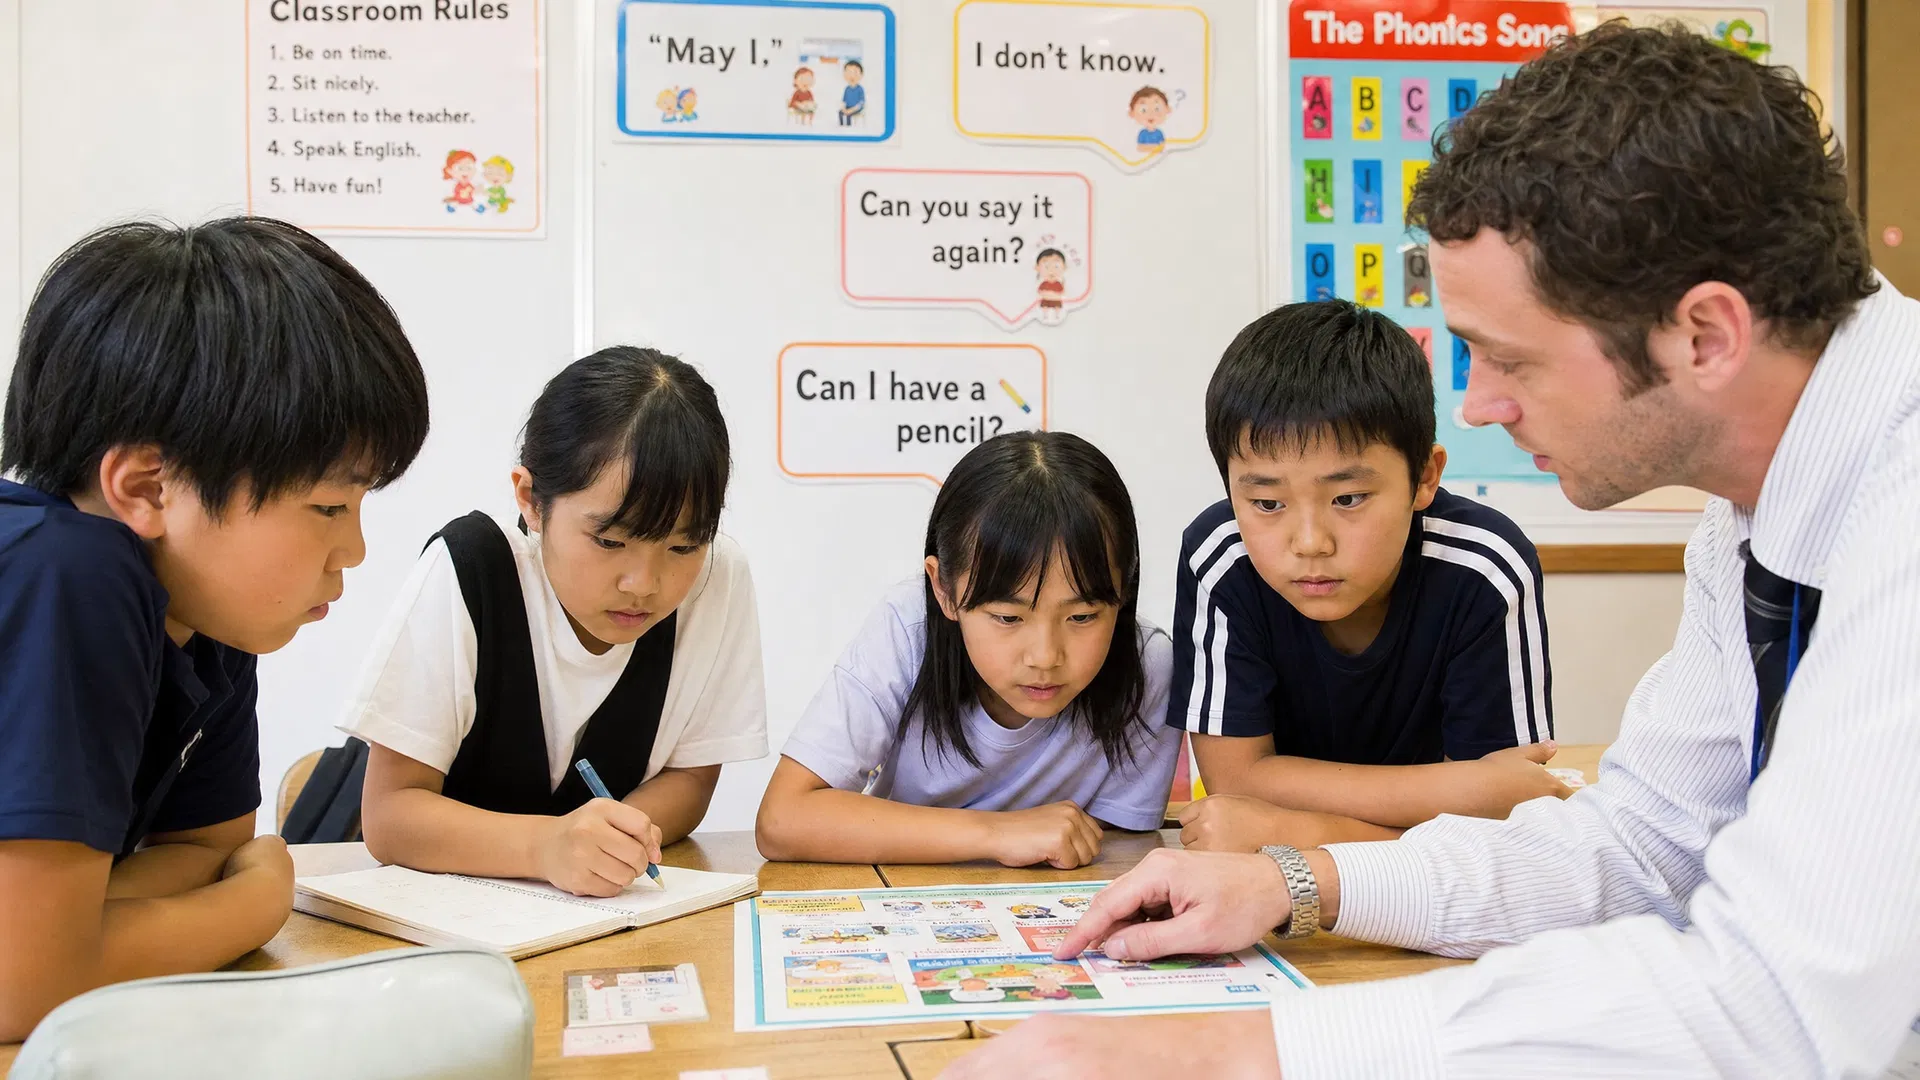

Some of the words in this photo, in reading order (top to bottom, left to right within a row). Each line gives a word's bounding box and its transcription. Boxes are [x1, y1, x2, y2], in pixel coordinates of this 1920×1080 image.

[270, 0, 422, 22] Classroom
[434, 0, 509, 20] Rules
[1303, 10, 1364, 45] The
[1373, 12, 1488, 46] Phonics
[270, 45, 284, 60] 1.
[293, 45, 314, 60] Be
[322, 49, 343, 60] on
[350, 46, 393, 60] time.
[975, 42, 982, 67] I
[995, 43, 1068, 70] don’t
[1081, 46, 1165, 74] know.
[268, 76, 285, 91] 2.
[293, 76, 317, 90] Sit
[325, 76, 379, 94] nicely.
[1309, 86, 1327, 111] A
[1359, 86, 1375, 111] B
[1406, 87, 1424, 112] C
[1455, 88, 1472, 112] D
[267, 107, 285, 123] 3.
[292, 108, 346, 123] Listen
[353, 109, 369, 123] to
[375, 108, 402, 123] the
[408, 108, 475, 124] teacher.
[267, 140, 285, 155] 4.
[293, 140, 346, 160] Speak
[354, 141, 421, 161] English.
[270, 177, 287, 193] 5.
[294, 177, 337, 193] Have
[346, 177, 382, 194] fun!
[1310, 168, 1328, 194] H
[860, 190, 910, 217] Can
[922, 200, 968, 224] you
[979, 201, 1022, 225] say
[1034, 195, 1053, 218] it
[932, 236, 1024, 270] again?
[1311, 252, 1329, 278] O
[1361, 253, 1377, 277] P
[1409, 254, 1427, 278] Q
[796, 369, 855, 401] Can
[869, 371, 876, 401] I
[890, 371, 959, 401] have
[970, 381, 986, 401] a
[897, 415, 1004, 452] pencil?
